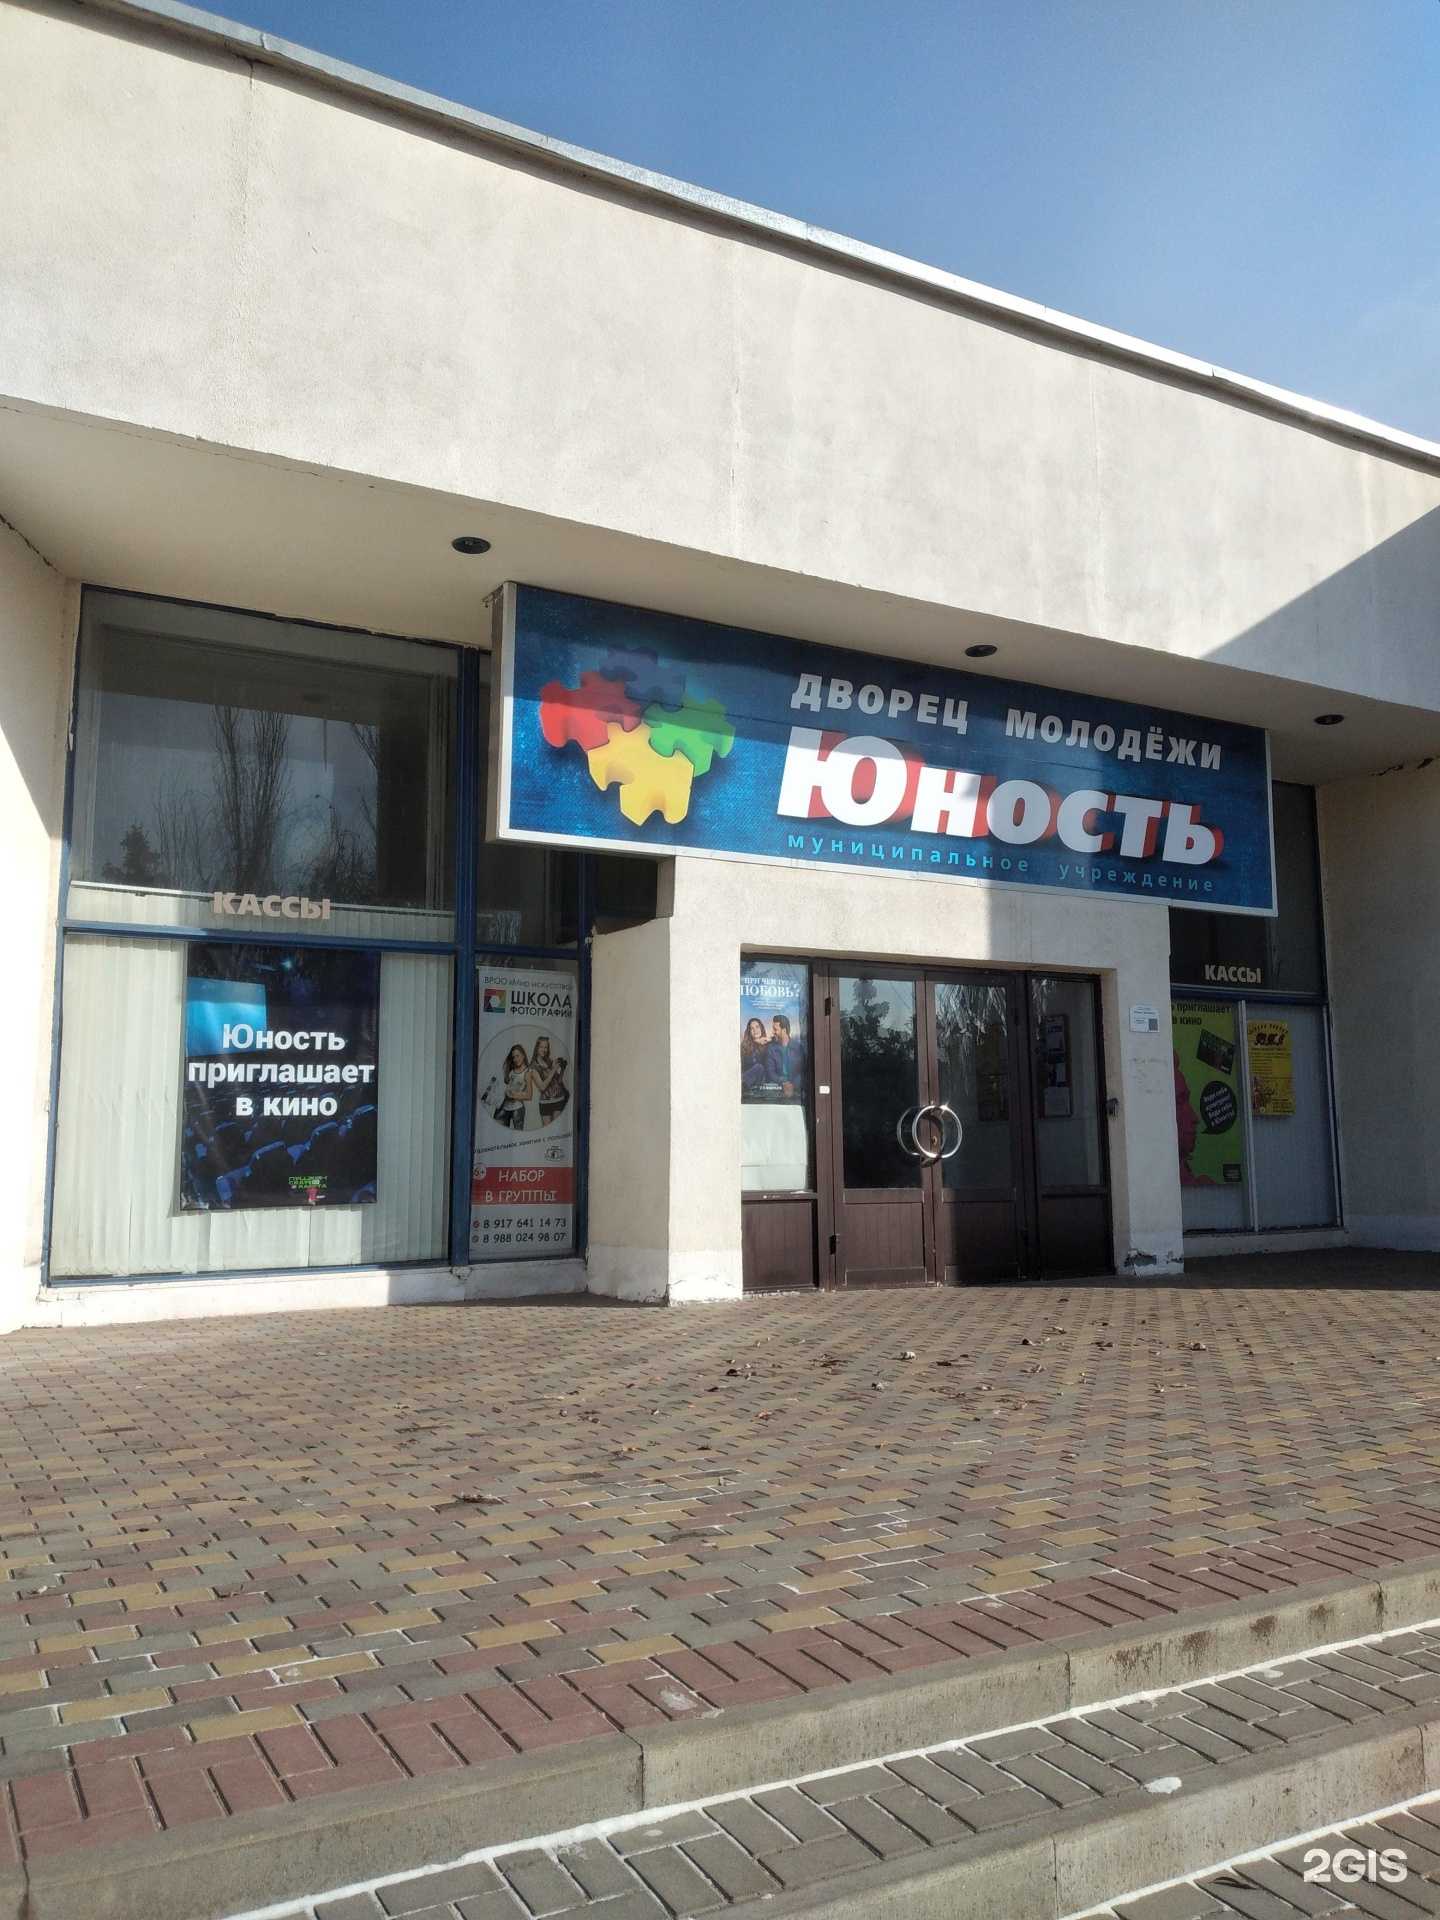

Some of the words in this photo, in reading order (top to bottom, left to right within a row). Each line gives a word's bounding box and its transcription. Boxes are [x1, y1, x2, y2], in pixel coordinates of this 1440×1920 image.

[790, 672, 968, 735] ДВОРЕЦ
[1005, 707, 1222, 770] МОЛОДЁЖИ
[788, 834, 1029, 872] муниципальное
[1059, 862, 1214, 893] учреждение
[212, 891, 331, 920] КАССЫ
[1204, 964, 1262, 983] КАССЫ
[511, 990, 572, 1009] ШКОЛА
[222, 1024, 346, 1050] Юность
[188, 1062, 375, 1088] приглашает
[235, 1097, 254, 1116] в
[263, 1097, 338, 1116] кино
[498, 1169, 545, 1183] НАБОР
[485, 1190, 493, 1202] В
[499, 1189, 558, 1202] ГРУППЫ
[483, 1219, 490, 1229] 8
[494, 1218, 513, 1228] 917
[516, 1218, 534, 1228] 641
[540, 1218, 551, 1228] 14
[555, 1218, 566, 1227] 73
[482, 1234, 489, 1243] 8
[493, 1233, 512, 1243] 988
[515, 1233, 534, 1242] 024
[538, 1232, 550, 1242] 98
[554, 1232, 566, 1242] 07
